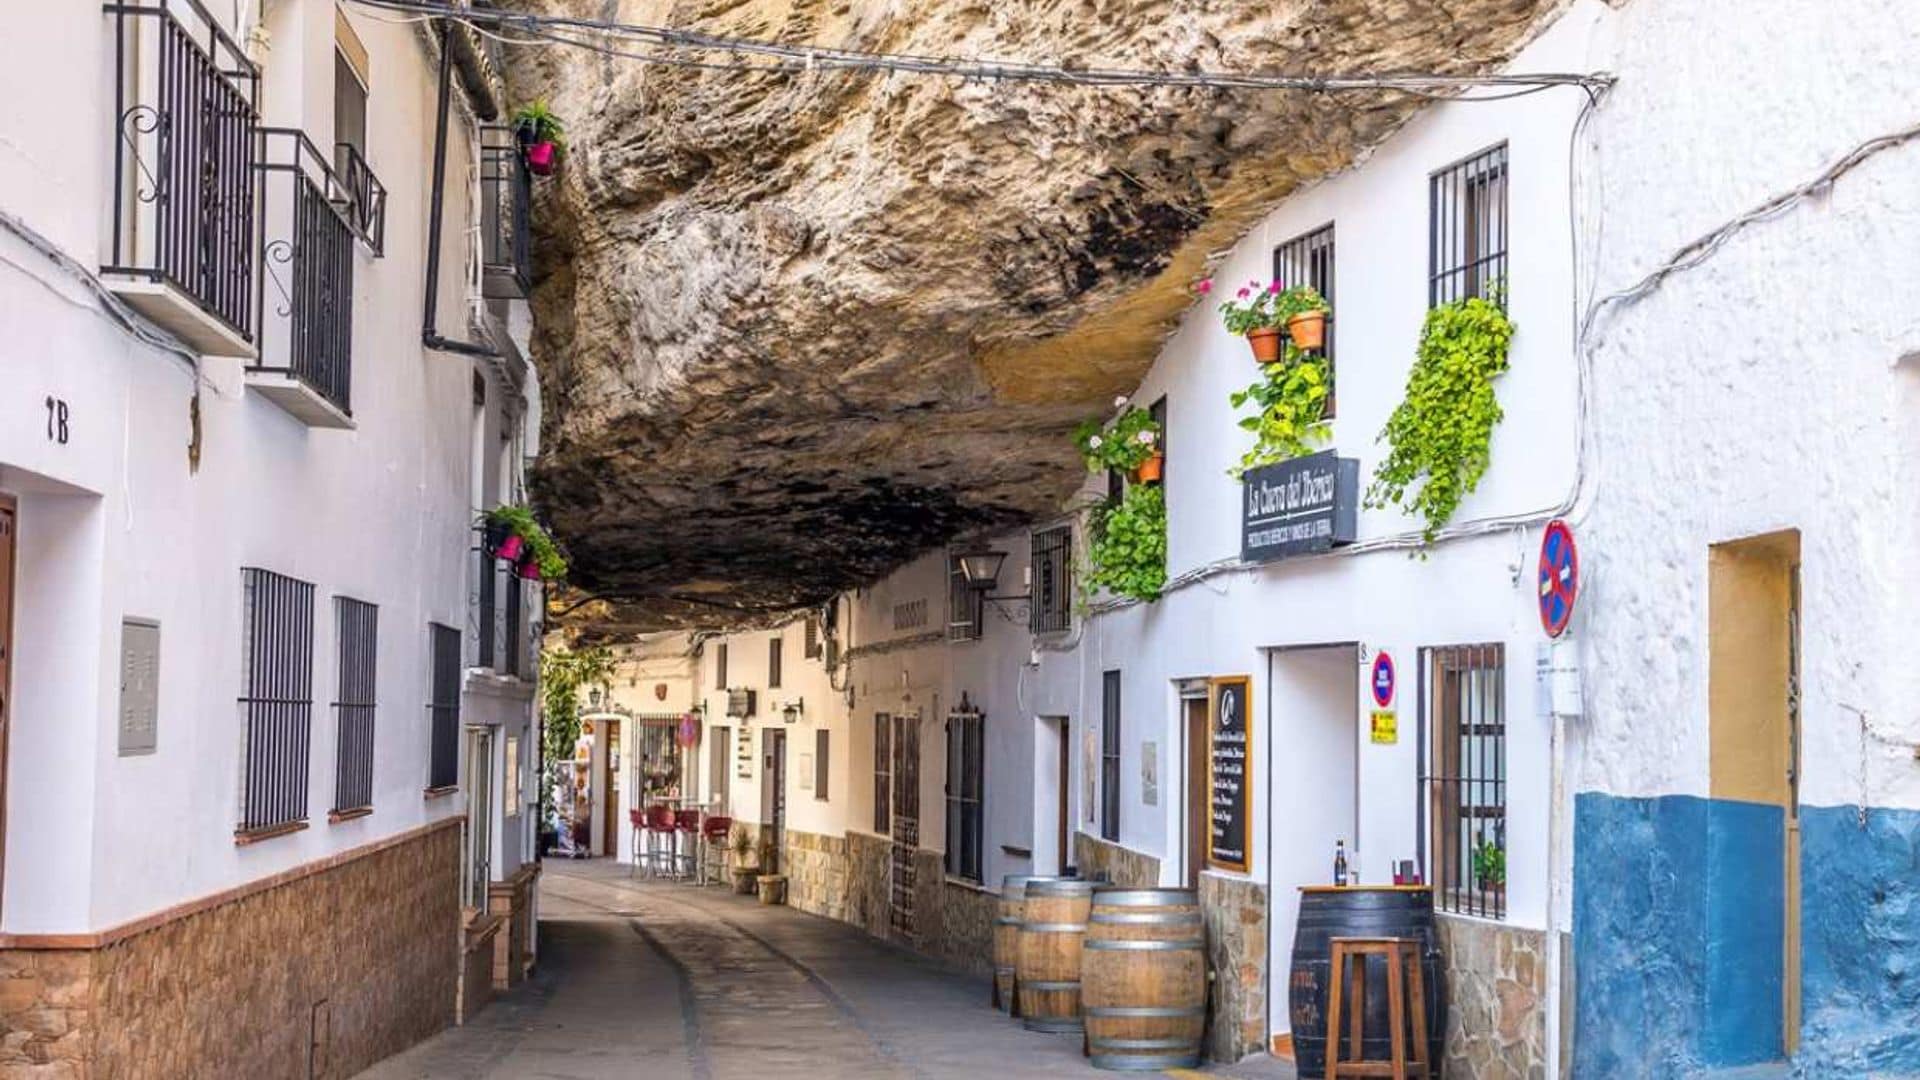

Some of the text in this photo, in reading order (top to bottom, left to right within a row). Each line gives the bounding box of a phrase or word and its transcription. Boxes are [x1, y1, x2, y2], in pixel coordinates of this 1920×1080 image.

[46, 395, 69, 445] 7B
[1248, 483, 1259, 518] La
[1286, 472, 1302, 509] del
[1302, 468, 1335, 507] Ibérico
